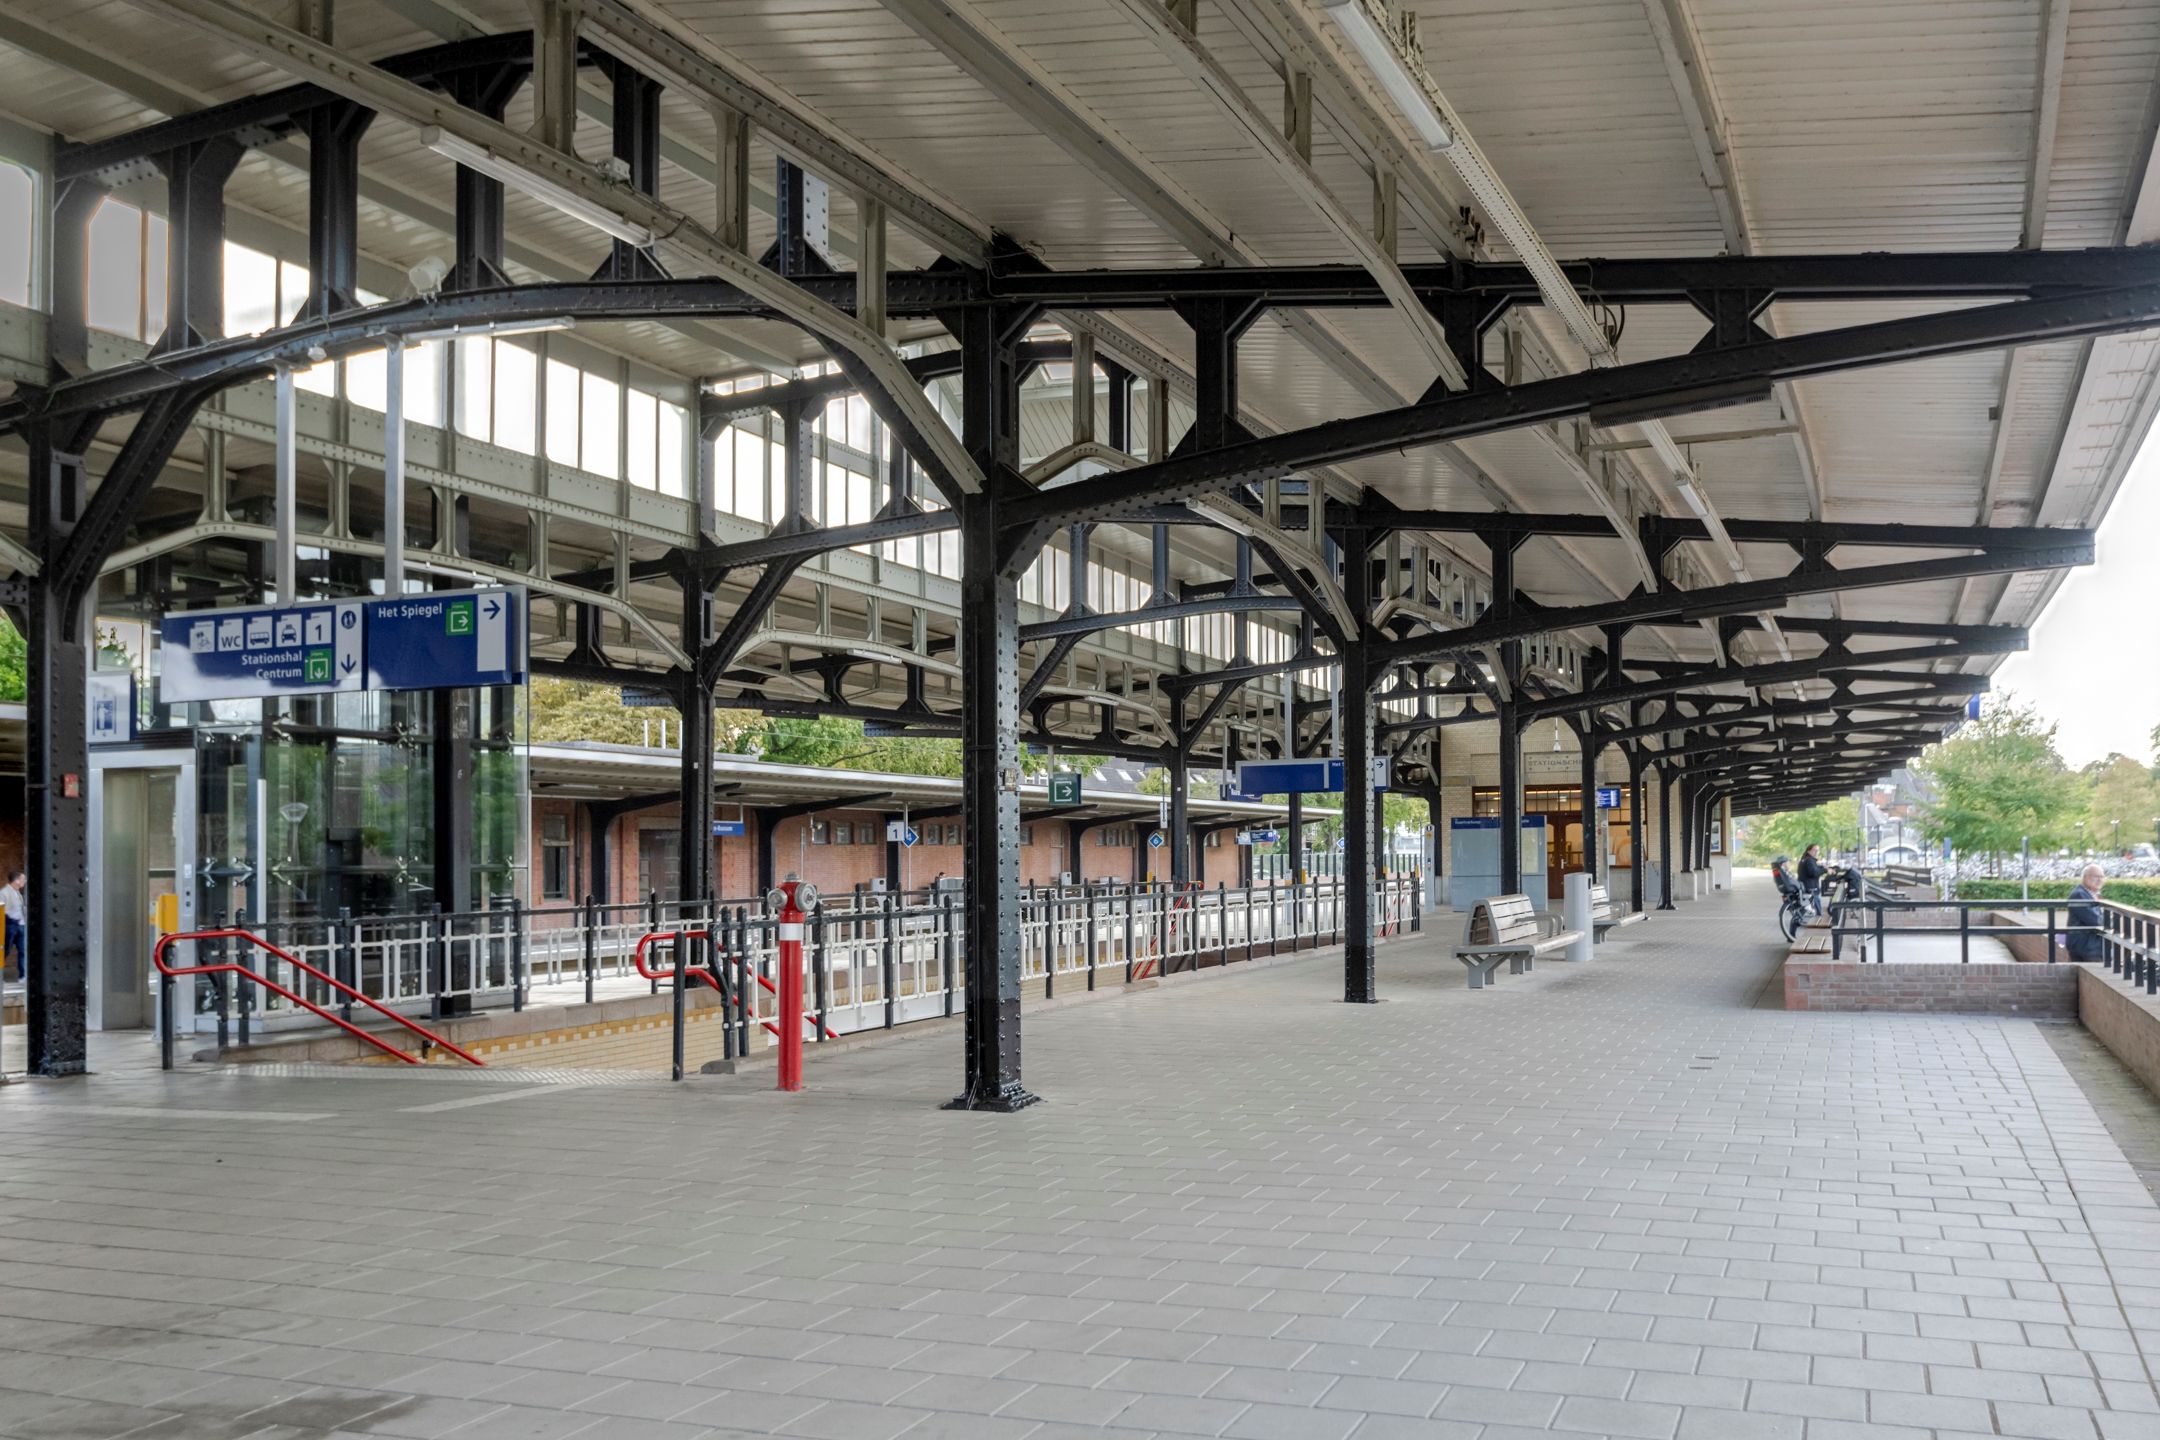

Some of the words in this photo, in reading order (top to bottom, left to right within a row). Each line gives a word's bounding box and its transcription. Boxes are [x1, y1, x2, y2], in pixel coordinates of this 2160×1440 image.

[378, 607, 398, 618] Het
[401, 602, 442, 619] Spiegel
[315, 624, 322, 641] 1
[221, 635, 241, 648] WC
[241, 650, 302, 666] Stationshal
[255, 667, 302, 680] Centrum
[892, 828, 899, 839] 1
